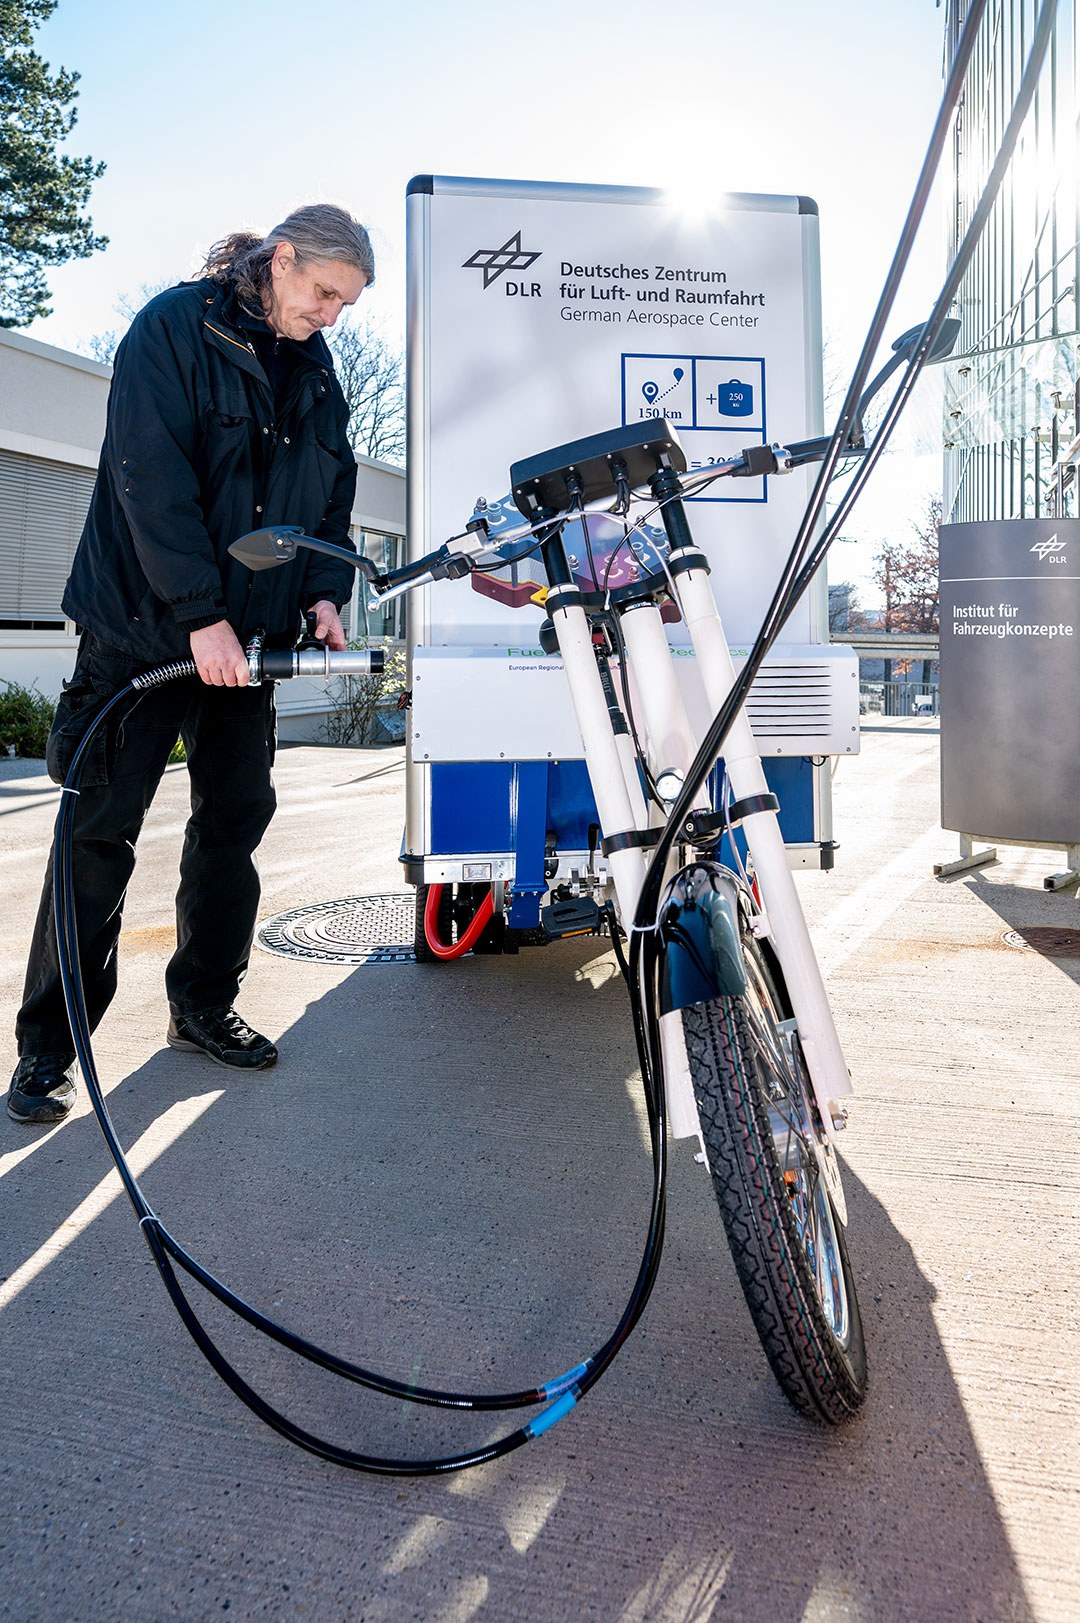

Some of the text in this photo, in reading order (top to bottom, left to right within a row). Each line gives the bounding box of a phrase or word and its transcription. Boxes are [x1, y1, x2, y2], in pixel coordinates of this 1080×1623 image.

[560, 262, 727, 283] Deutsches Zentrum
[506, 282, 542, 298] DLR
[560, 283, 765, 306] für Luft- und Raumfahrt
[560, 306, 759, 327] German Aerospace Center
[729, 392, 744, 401] 250
[639, 408, 682, 419] 150 km
[953, 603, 1019, 618] Institut für
[953, 621, 1073, 639] Fahrzeugkonzepte
